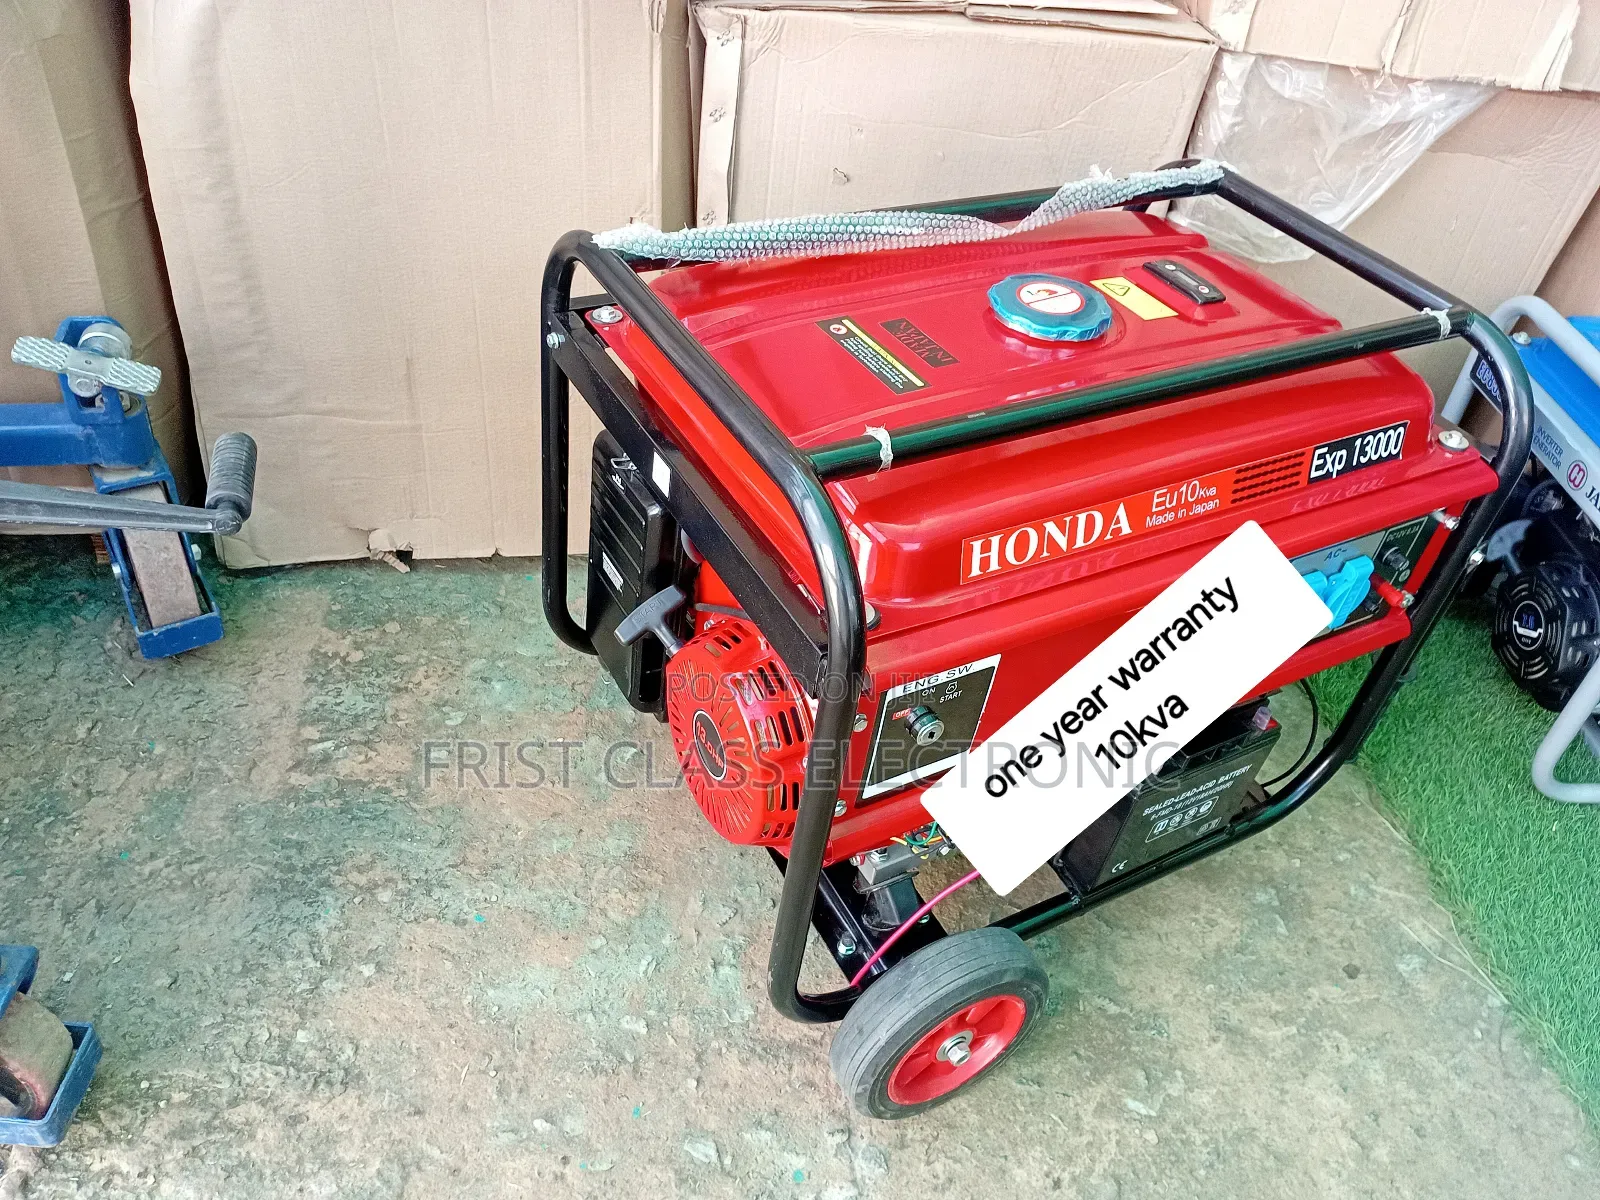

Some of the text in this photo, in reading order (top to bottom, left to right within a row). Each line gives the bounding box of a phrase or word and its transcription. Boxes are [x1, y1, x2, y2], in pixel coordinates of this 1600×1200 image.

[1310, 426, 1405, 479] Exp 13000
[1537, 425, 1564, 458] INVERTER
[1145, 498, 1221, 529] Made in Japan
[967, 502, 1133, 579] HONDA
[921, 686, 937, 697] ON
[939, 689, 963, 704] START
[1217, 763, 1253, 784] BATTERY
